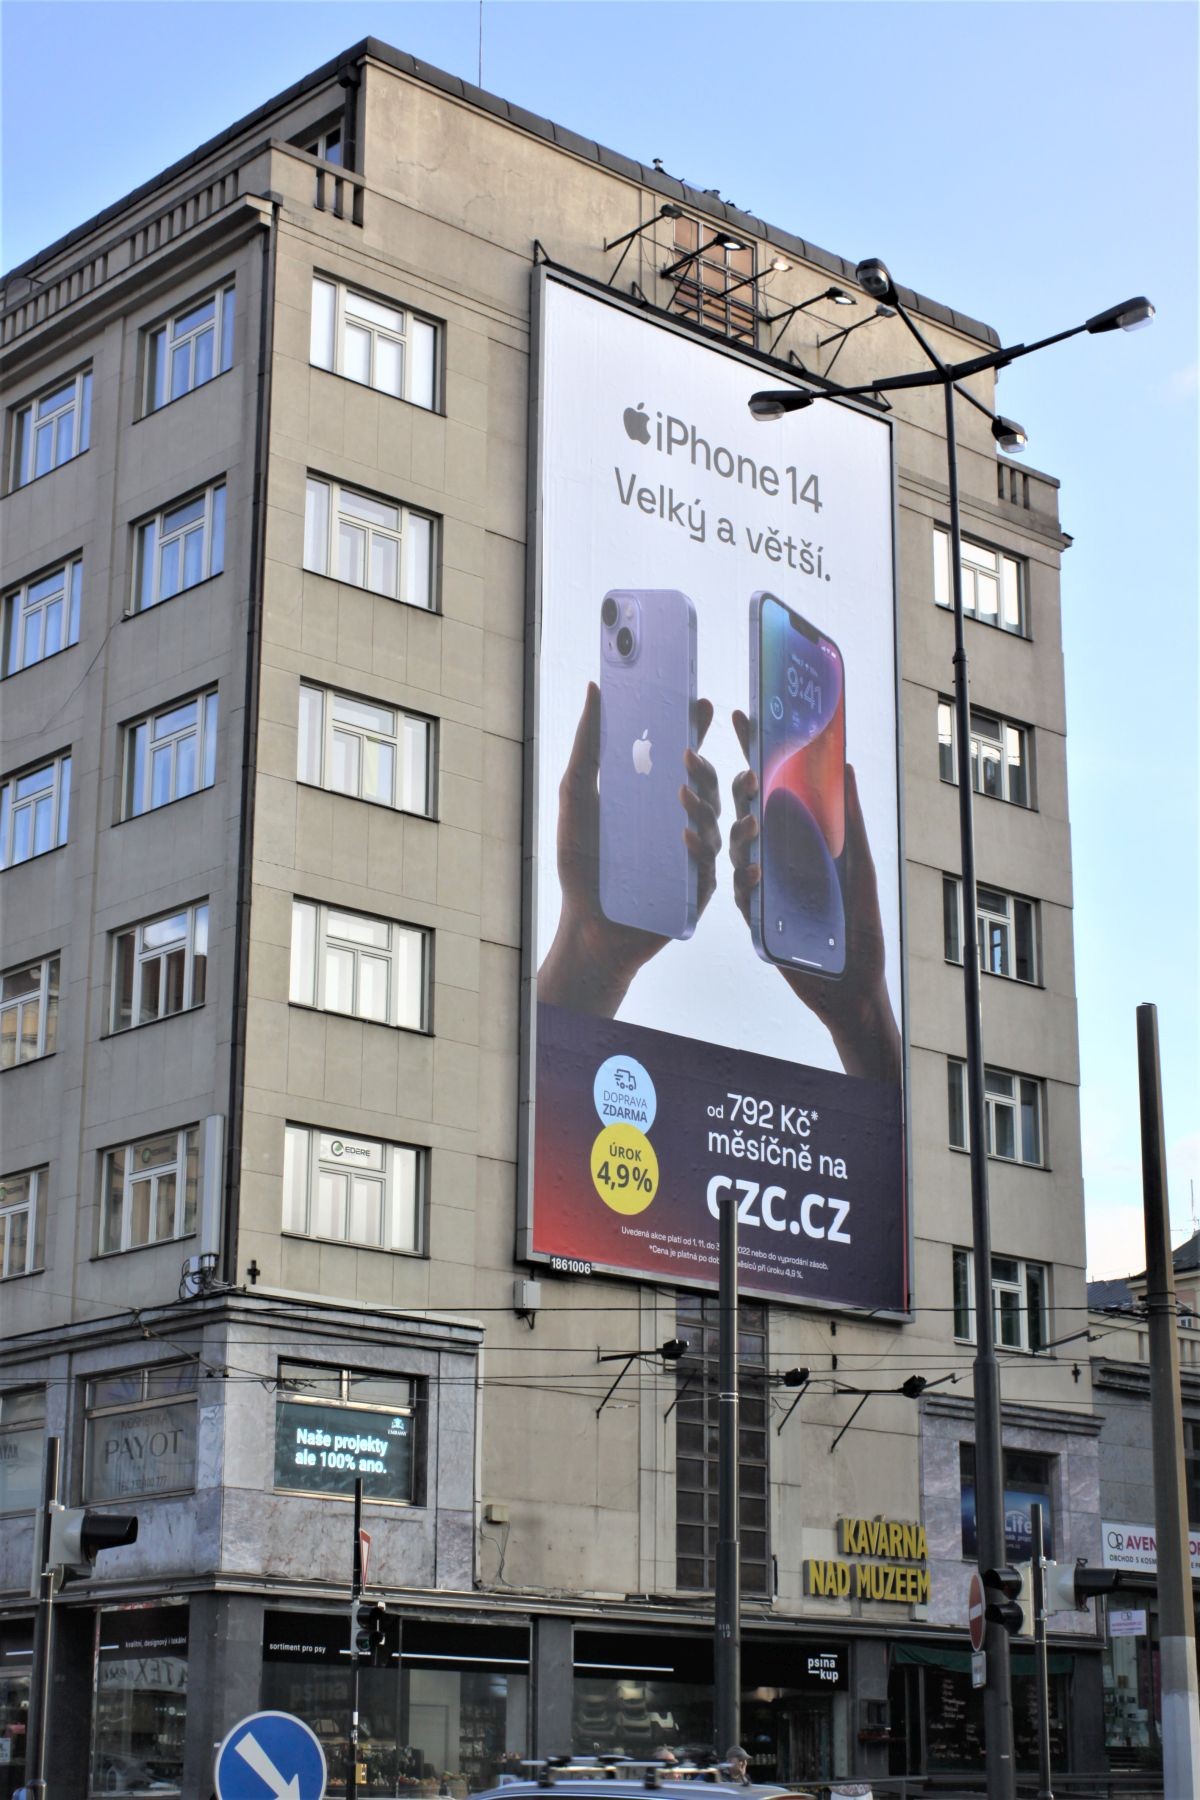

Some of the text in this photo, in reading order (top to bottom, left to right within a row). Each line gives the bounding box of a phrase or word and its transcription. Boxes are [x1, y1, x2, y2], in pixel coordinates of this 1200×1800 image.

[656, 411, 823, 513] iPhone 14
[614, 466, 831, 582] Velký a větší.
[602, 1090, 648, 1109] DOPRAVA
[602, 1103, 648, 1123] ZDARMA
[707, 1104, 724, 1119] od
[727, 1093, 774, 1129] 792
[609, 1142, 642, 1162] ÚROK
[708, 1129, 848, 1179] měsíčně na
[621, 1225, 650, 1238] Uvedená
[650, 1232, 667, 1241] akce
[667, 1235, 682, 1244] platí
[706, 1241, 716, 1250] do
[737, 1246, 751, 1256] 022
[751, 1250, 767, 1259] nebo
[768, 1252, 777, 1261] do
[777, 1255, 809, 1266] vyprodání
[551, 1257, 591, 1274] 1861006
[669, 1248, 676, 1258] je
[677, 1250, 697, 1261] platná
[698, 1255, 707, 1263] po
[708, 1256, 720, 1264] dob
[766, 1265, 785, 1276] úroku
[104, 1428, 184, 1465] PAYOT
[296, 1427, 389, 1457] Naše projekty
[295, 1448, 388, 1474] ale 100% ano.
[1109, 1554, 1134, 1563] OBCHOD
[1135, 1556, 1140, 1564] S
[805, 1559, 931, 1605] NAD MUZEEM
[269, 1643, 326, 1655] sortiment pro psy
[808, 1656, 836, 1670] psina
[819, 1669, 839, 1683] kup
